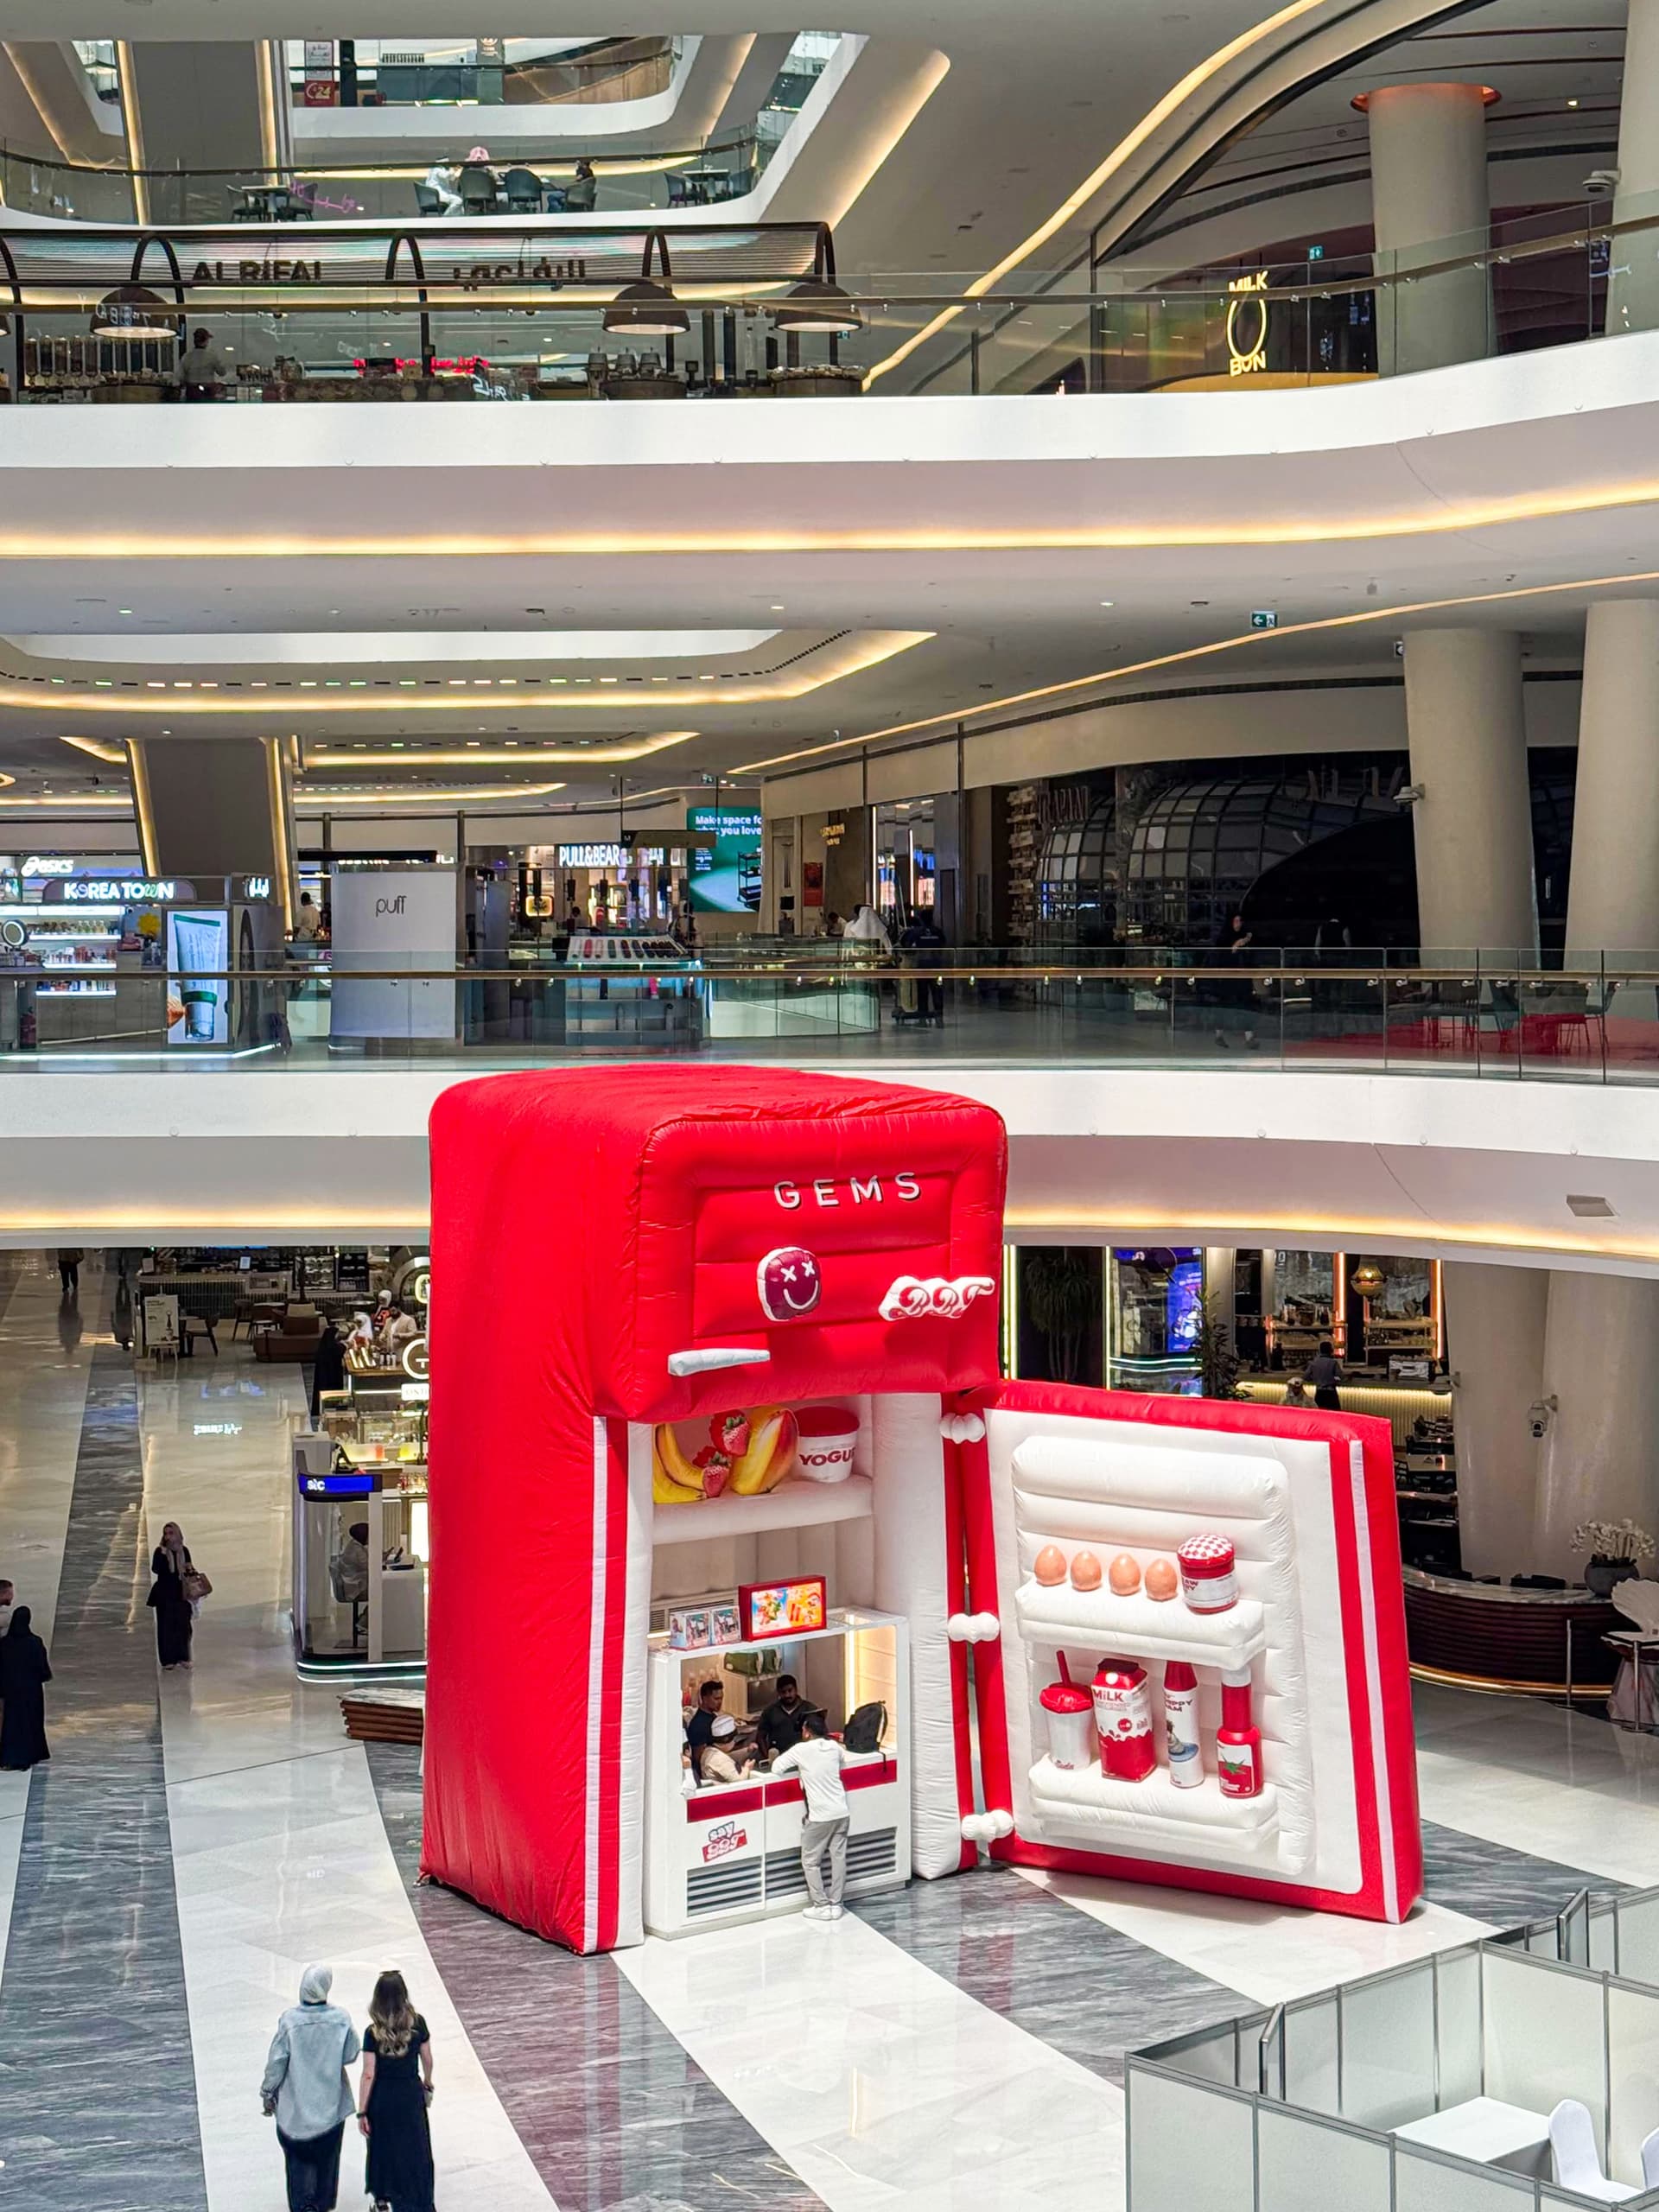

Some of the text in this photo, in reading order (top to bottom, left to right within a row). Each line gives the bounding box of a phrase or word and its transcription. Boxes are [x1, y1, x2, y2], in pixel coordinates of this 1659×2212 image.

[193, 260, 321, 281] AL RIFAI
[1229, 270, 1268, 292] MILK
[721, 827, 740, 836] you
[722, 817, 751, 826] space
[559, 844, 620, 867] PULL&BEAR
[64, 881, 174, 899] KOREA TOWN
[376, 895, 407, 918] puff
[774, 1172, 920, 1209] GEMS
[709, 1821, 735, 1842] say
